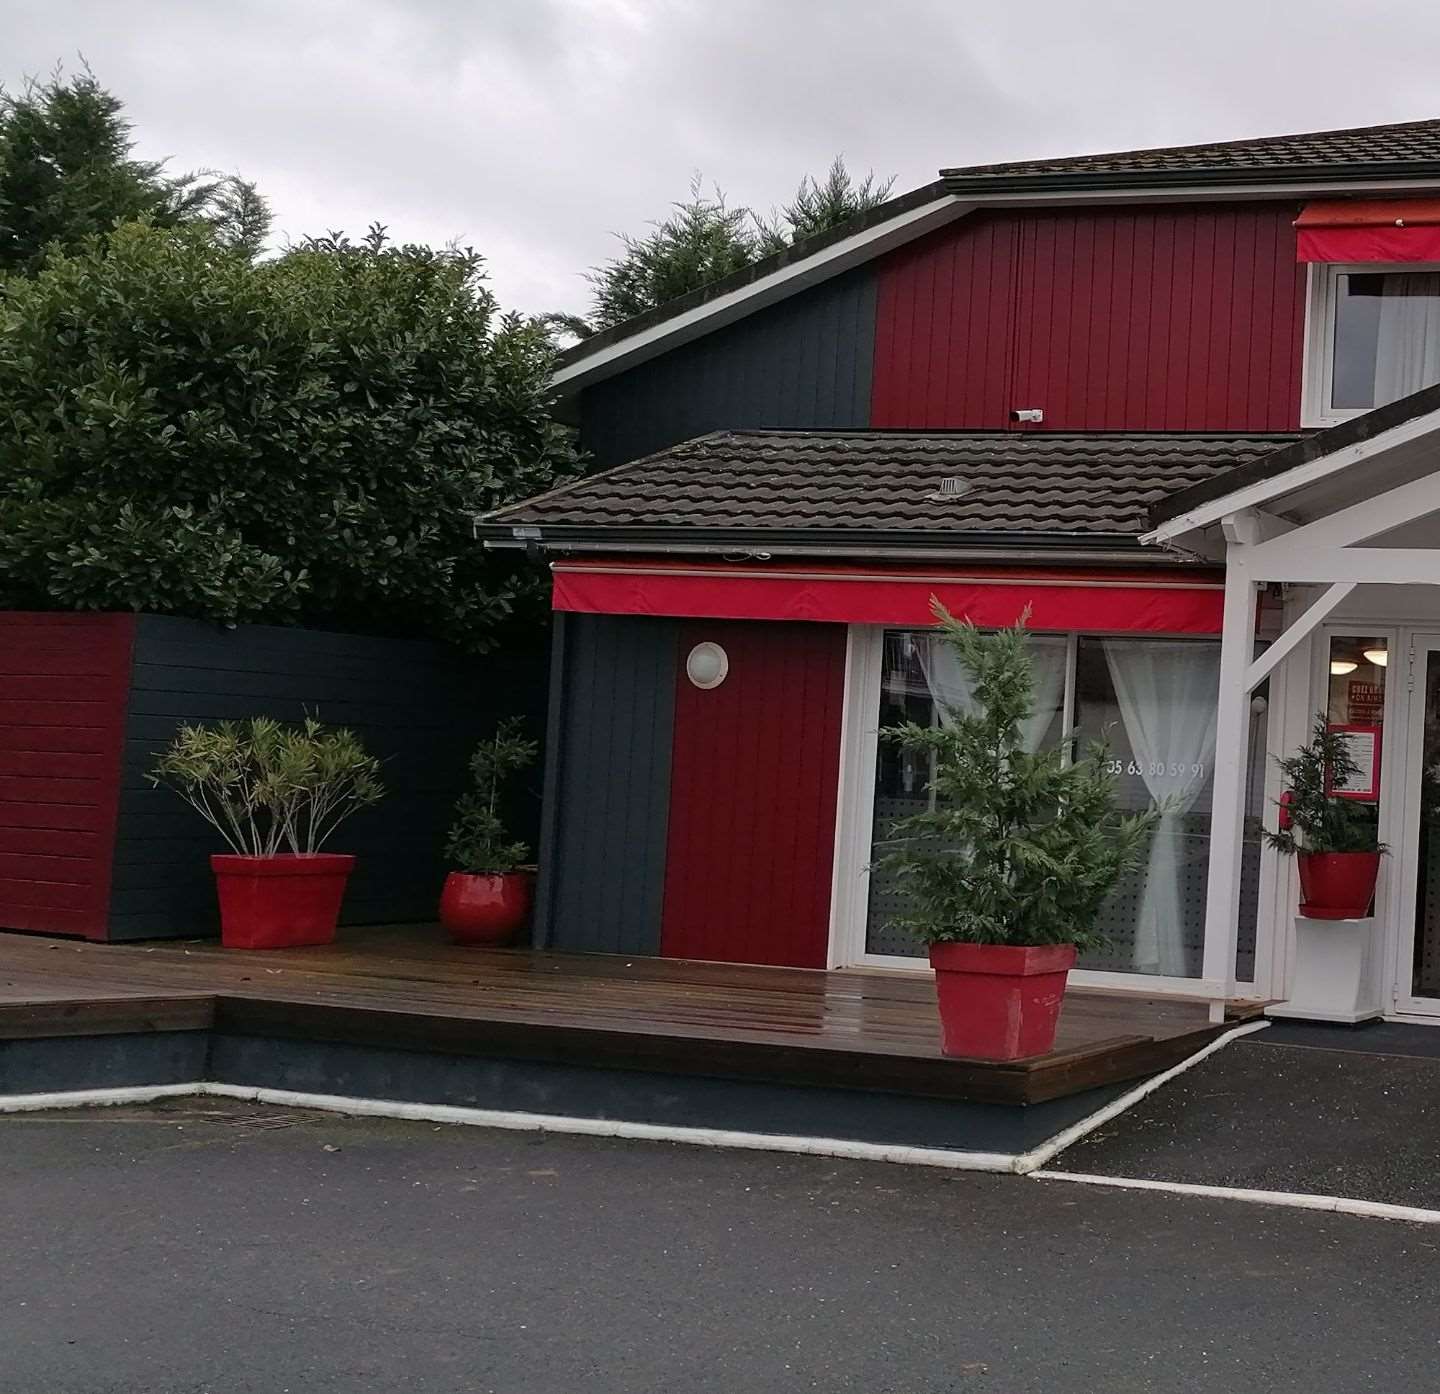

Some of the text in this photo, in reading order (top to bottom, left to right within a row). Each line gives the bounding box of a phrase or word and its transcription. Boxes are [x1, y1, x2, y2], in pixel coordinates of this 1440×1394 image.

[1128, 761, 1143, 775] 63
[1149, 762, 1165, 776] 80
[1170, 763, 1185, 777] 59
[1191, 764, 1204, 778] 91
